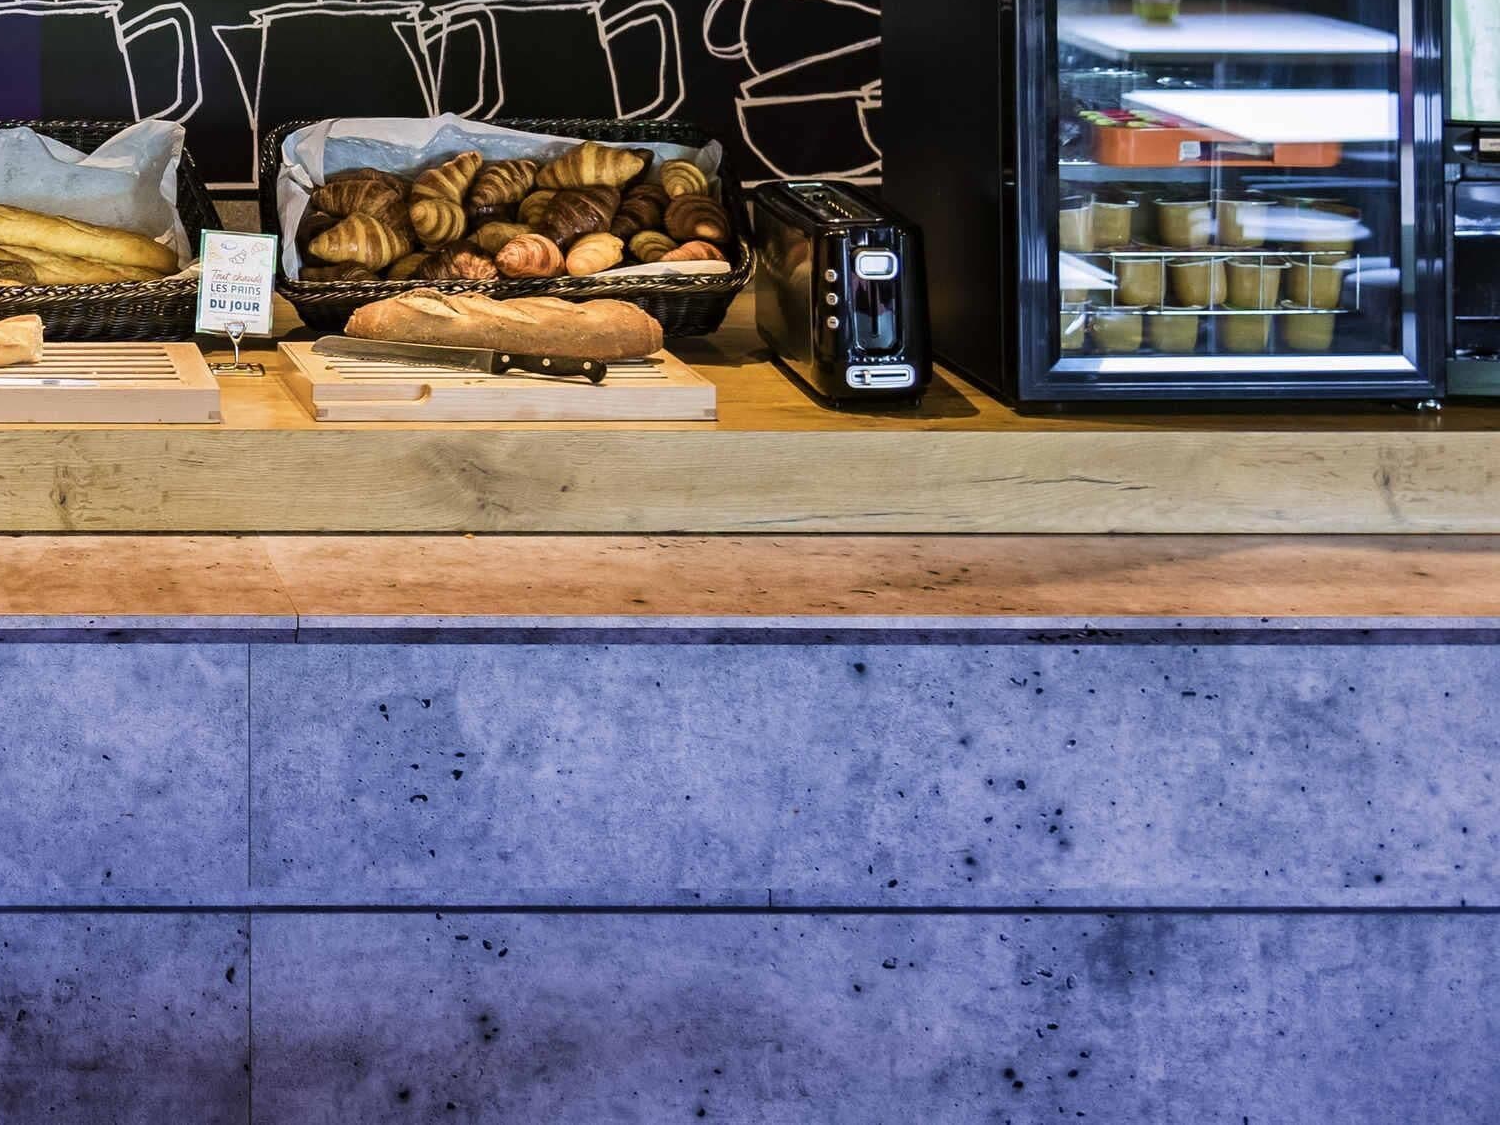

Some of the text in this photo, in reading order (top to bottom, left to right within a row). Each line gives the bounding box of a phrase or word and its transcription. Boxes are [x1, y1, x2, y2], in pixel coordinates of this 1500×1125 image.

[210, 283, 261, 295] LES PAINS
[209, 299, 260, 312] DU JOUR
